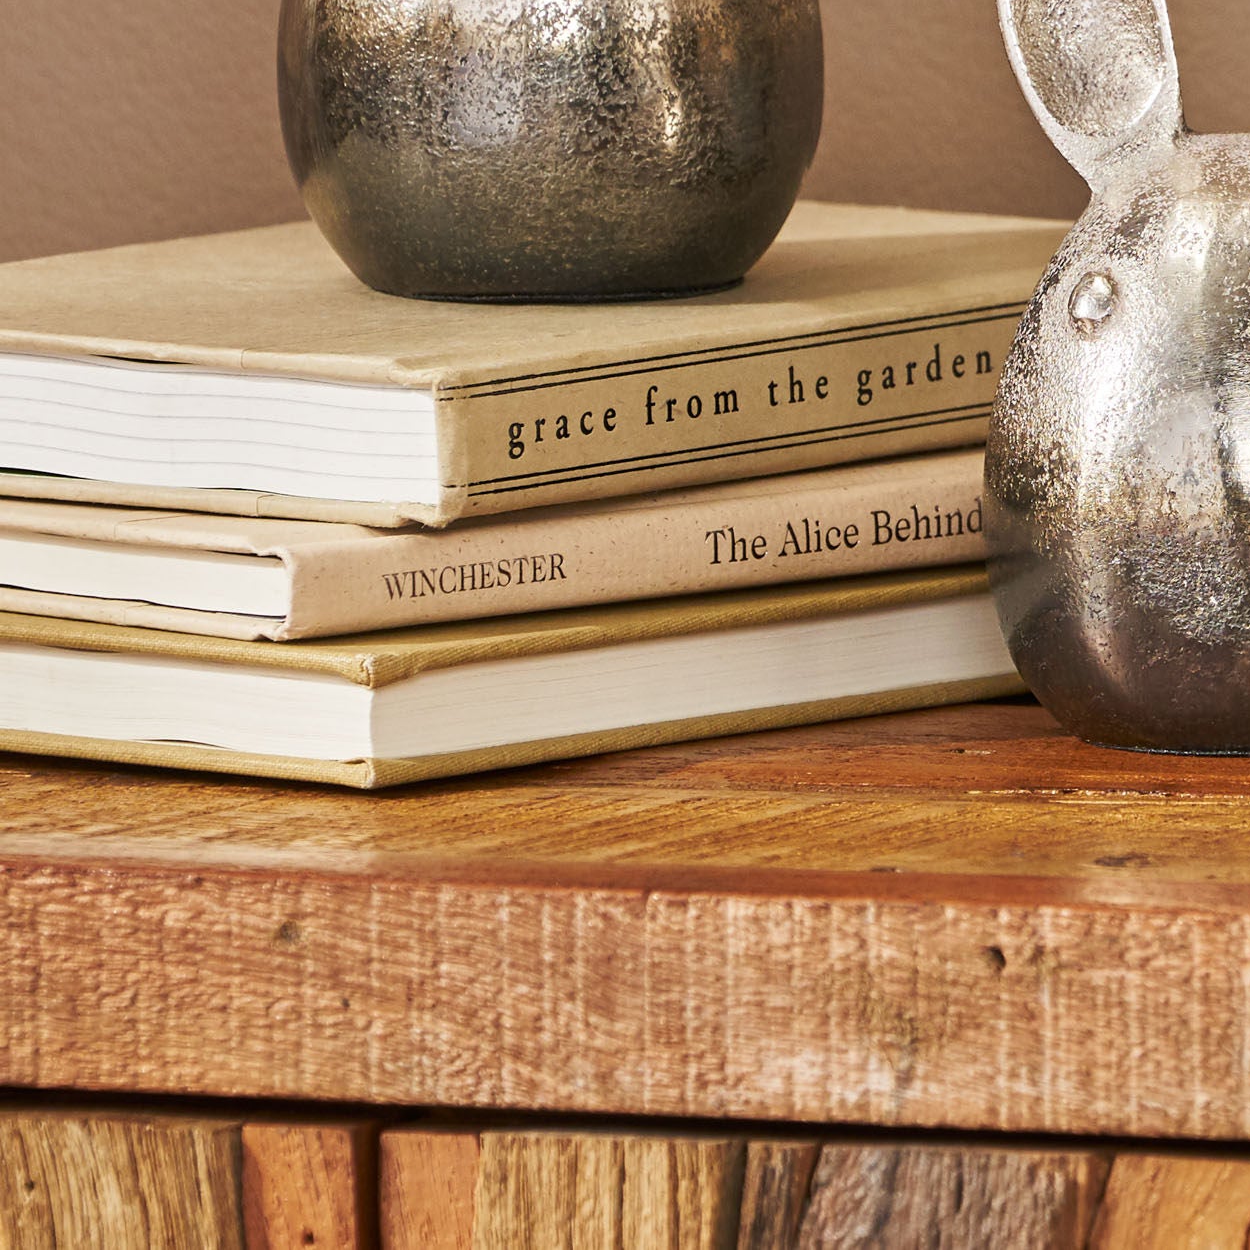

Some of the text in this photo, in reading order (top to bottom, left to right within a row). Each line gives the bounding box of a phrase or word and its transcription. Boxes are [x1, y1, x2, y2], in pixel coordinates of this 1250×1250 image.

[507, 344, 994, 460] grace from the garden
[705, 496, 983, 566] The Alice Behind
[382, 553, 567, 601] WINCHESTER
